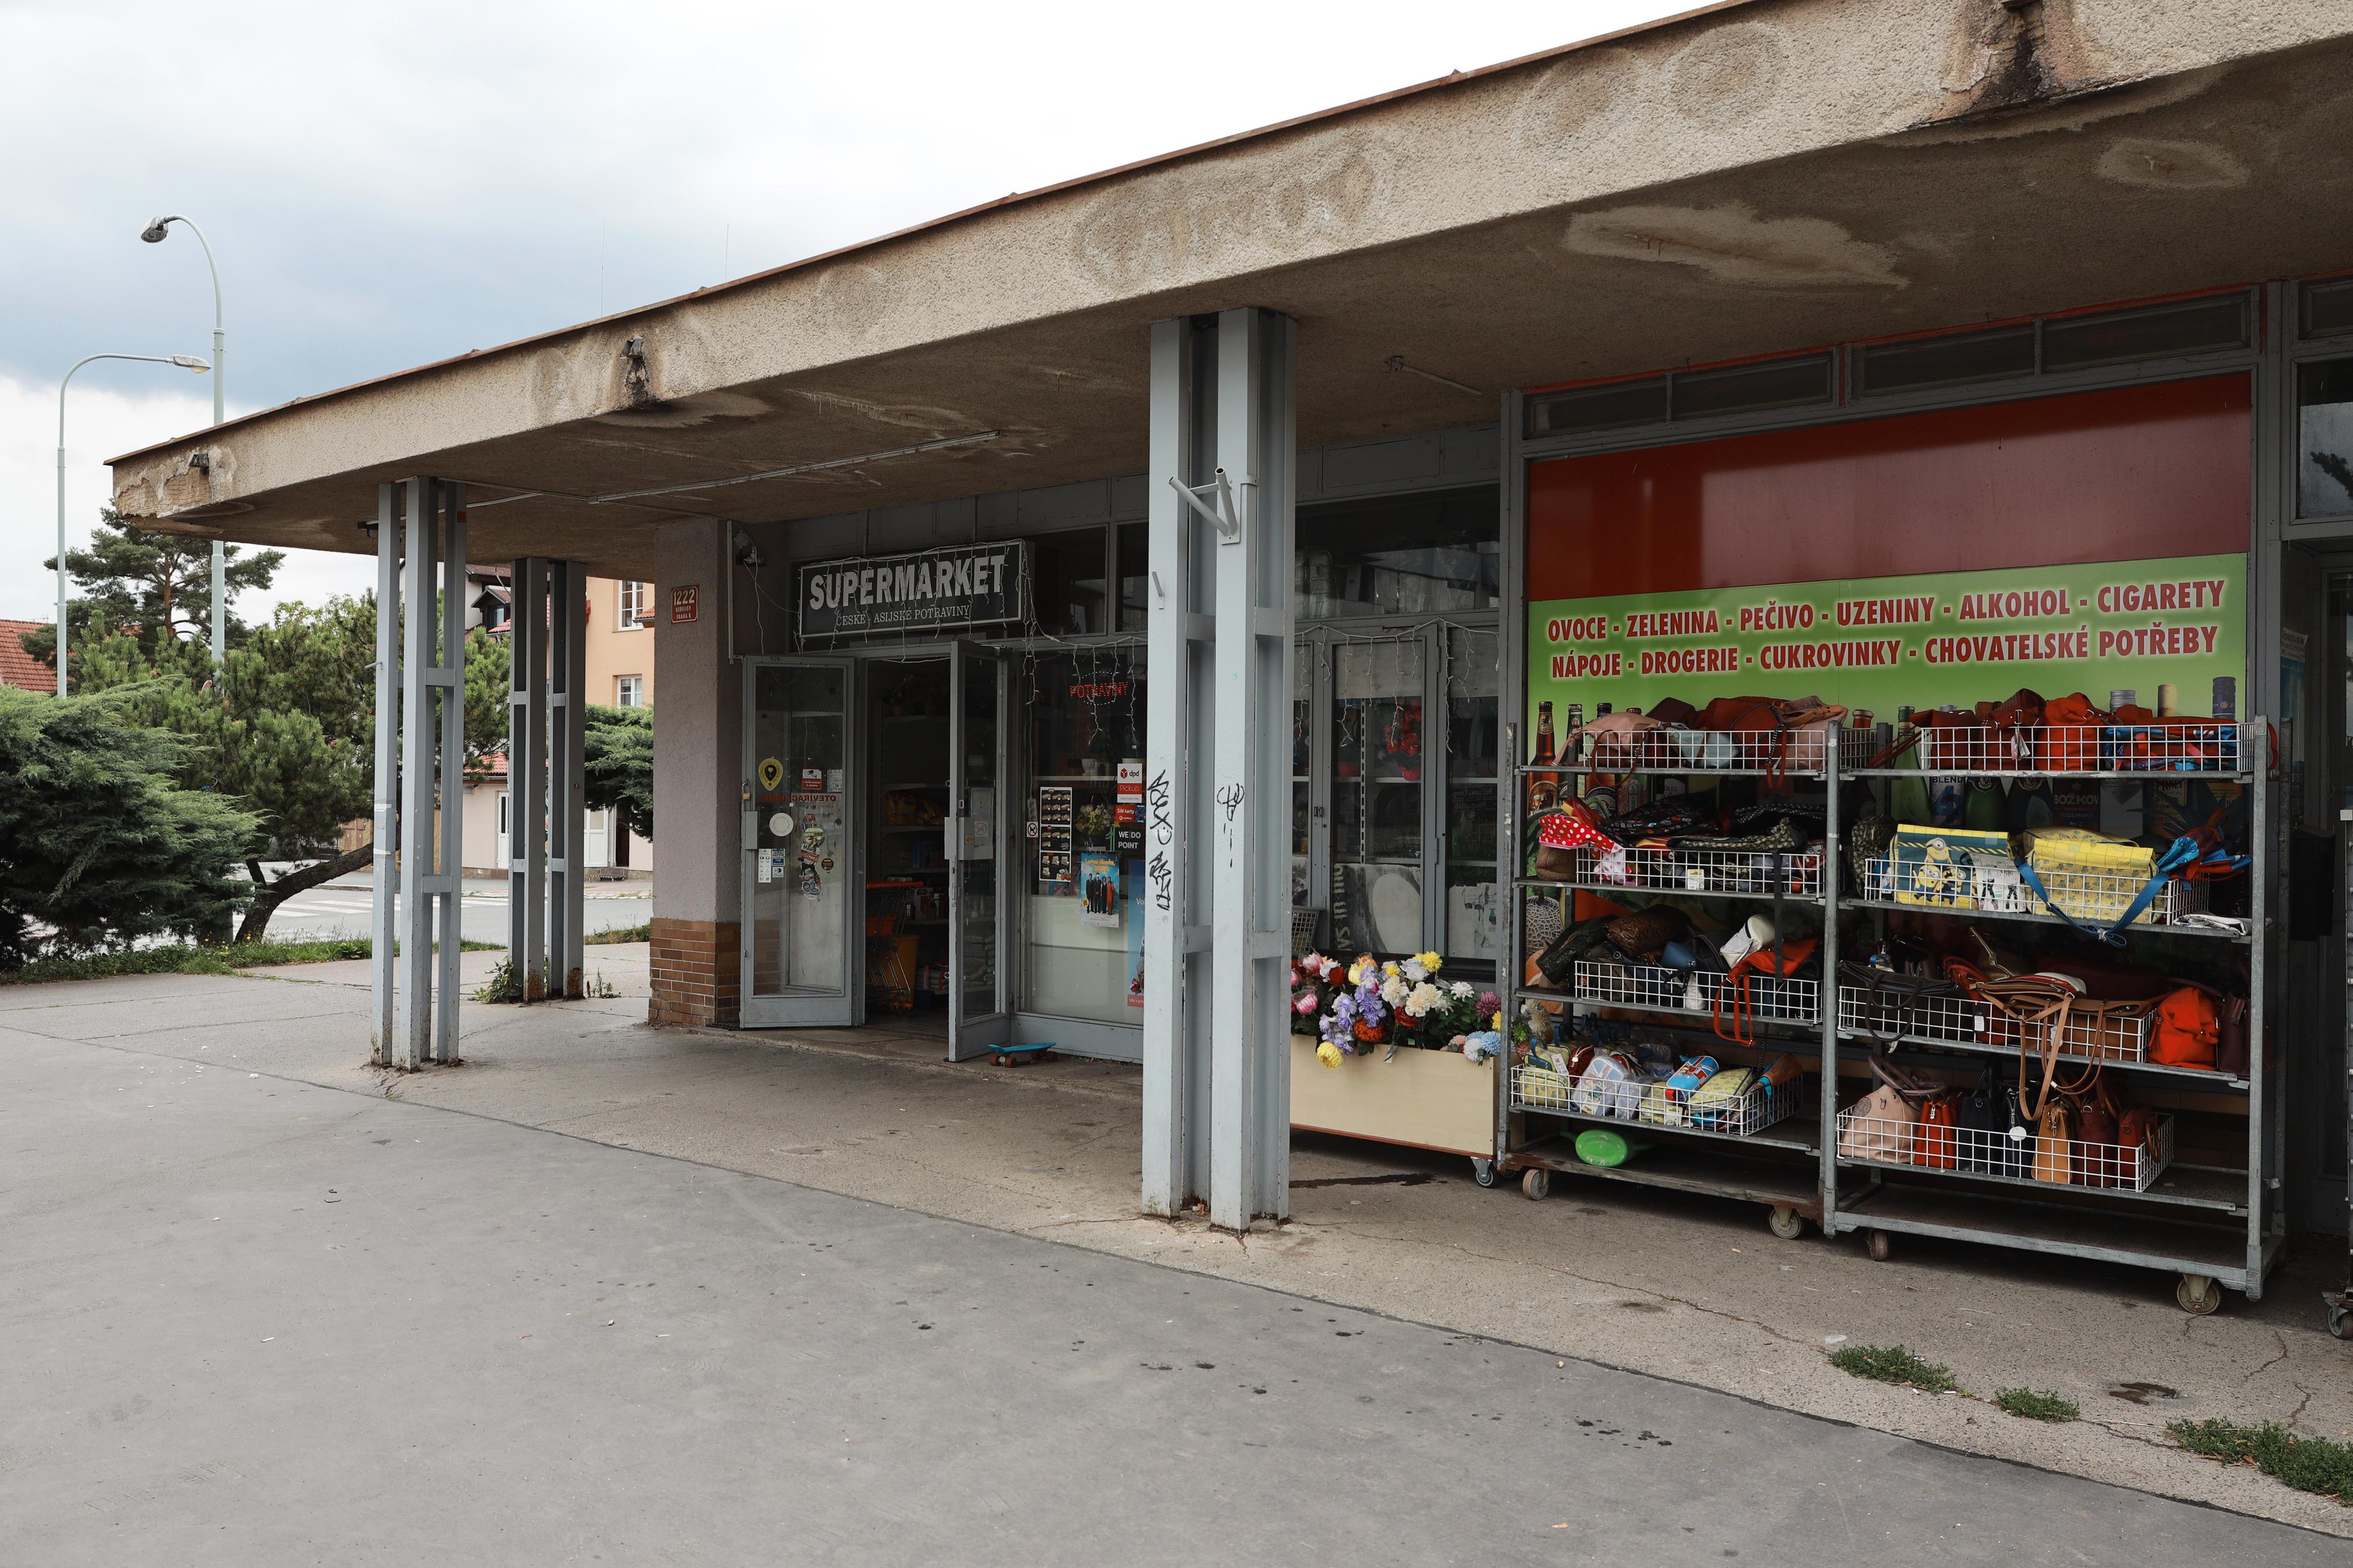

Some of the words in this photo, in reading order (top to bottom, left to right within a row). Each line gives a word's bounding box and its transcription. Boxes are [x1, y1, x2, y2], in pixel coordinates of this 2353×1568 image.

[809, 555, 1006, 610] SUPERMARKET
[674, 589, 695, 606] 1222
[873, 607, 912, 623] ASIJSKÉ
[914, 605, 970, 621] POTRAVINY
[1548, 617, 1607, 642] OVOCE
[1627, 610, 1718, 638] ZELENINA
[1741, 600, 1814, 631] PEČIVO
[1837, 596, 1935, 626] UZENINY
[1960, 589, 2070, 620] ALKOHOL
[2098, 580, 2224, 613] CIGARETY
[1552, 650, 1621, 678] NÁPOJE
[1641, 648, 1738, 674] DROGERIE
[1759, 639, 1901, 669] CUKROVINKY
[1925, 625, 2089, 663] CHOVATELSKÉ
[2099, 622, 2218, 658] POTŘEBY
[1069, 681, 1129, 699] POTRAVINY
[1119, 785, 1139, 793] Pickup
[2054, 793, 2099, 805] BOŽKOV
[1118, 841, 1139, 849] POINT
